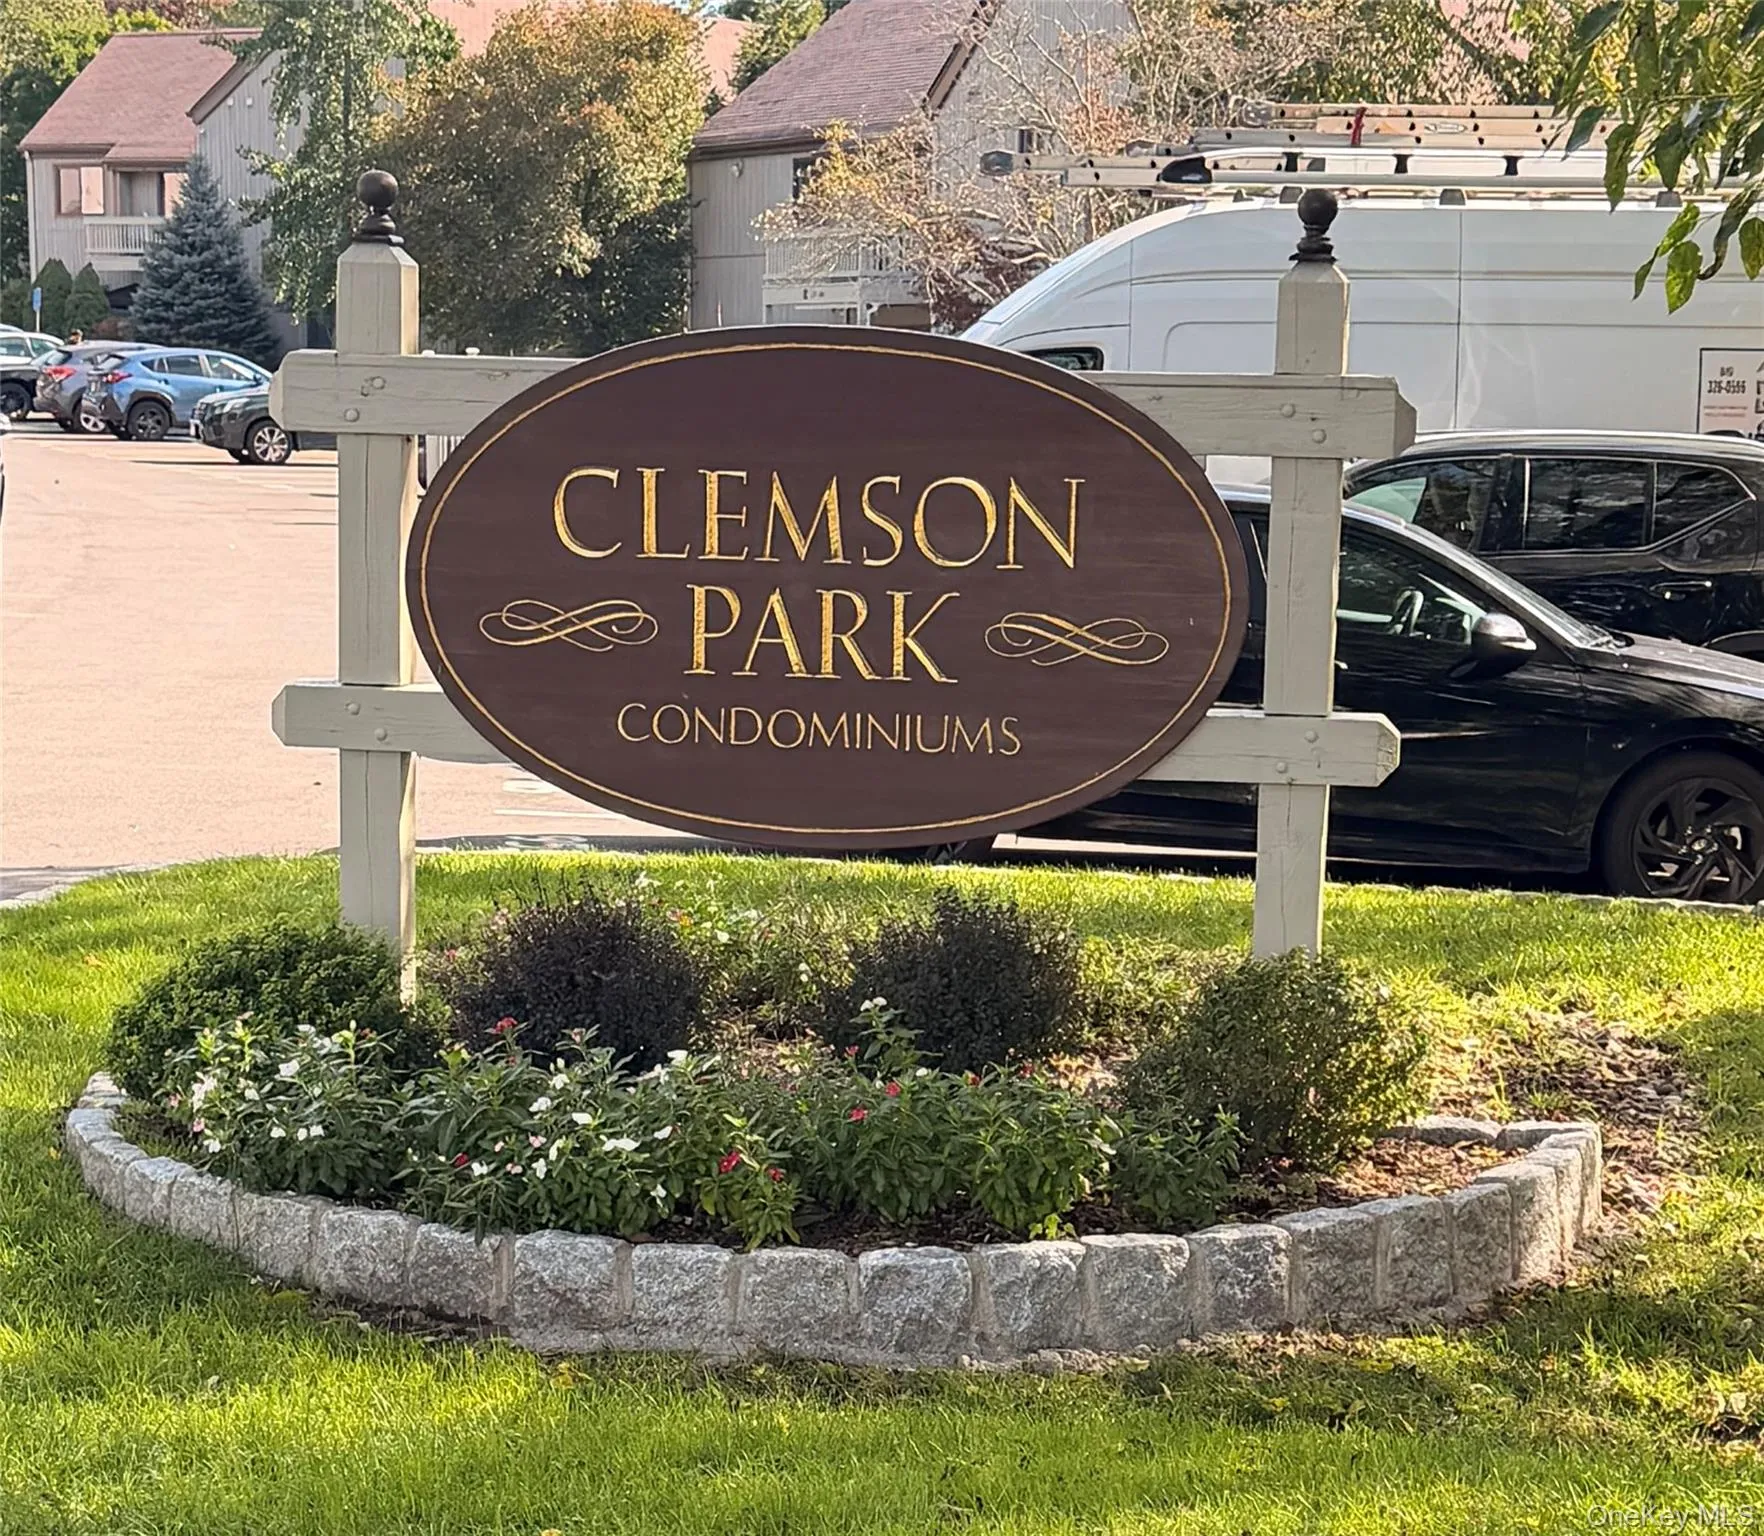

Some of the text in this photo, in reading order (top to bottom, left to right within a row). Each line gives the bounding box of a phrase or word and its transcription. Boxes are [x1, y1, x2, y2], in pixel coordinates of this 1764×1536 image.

[553, 467, 1085, 570] CLEMSON
[683, 584, 960, 684] PARK
[616, 703, 1022, 756] CONDOMINIUMS
